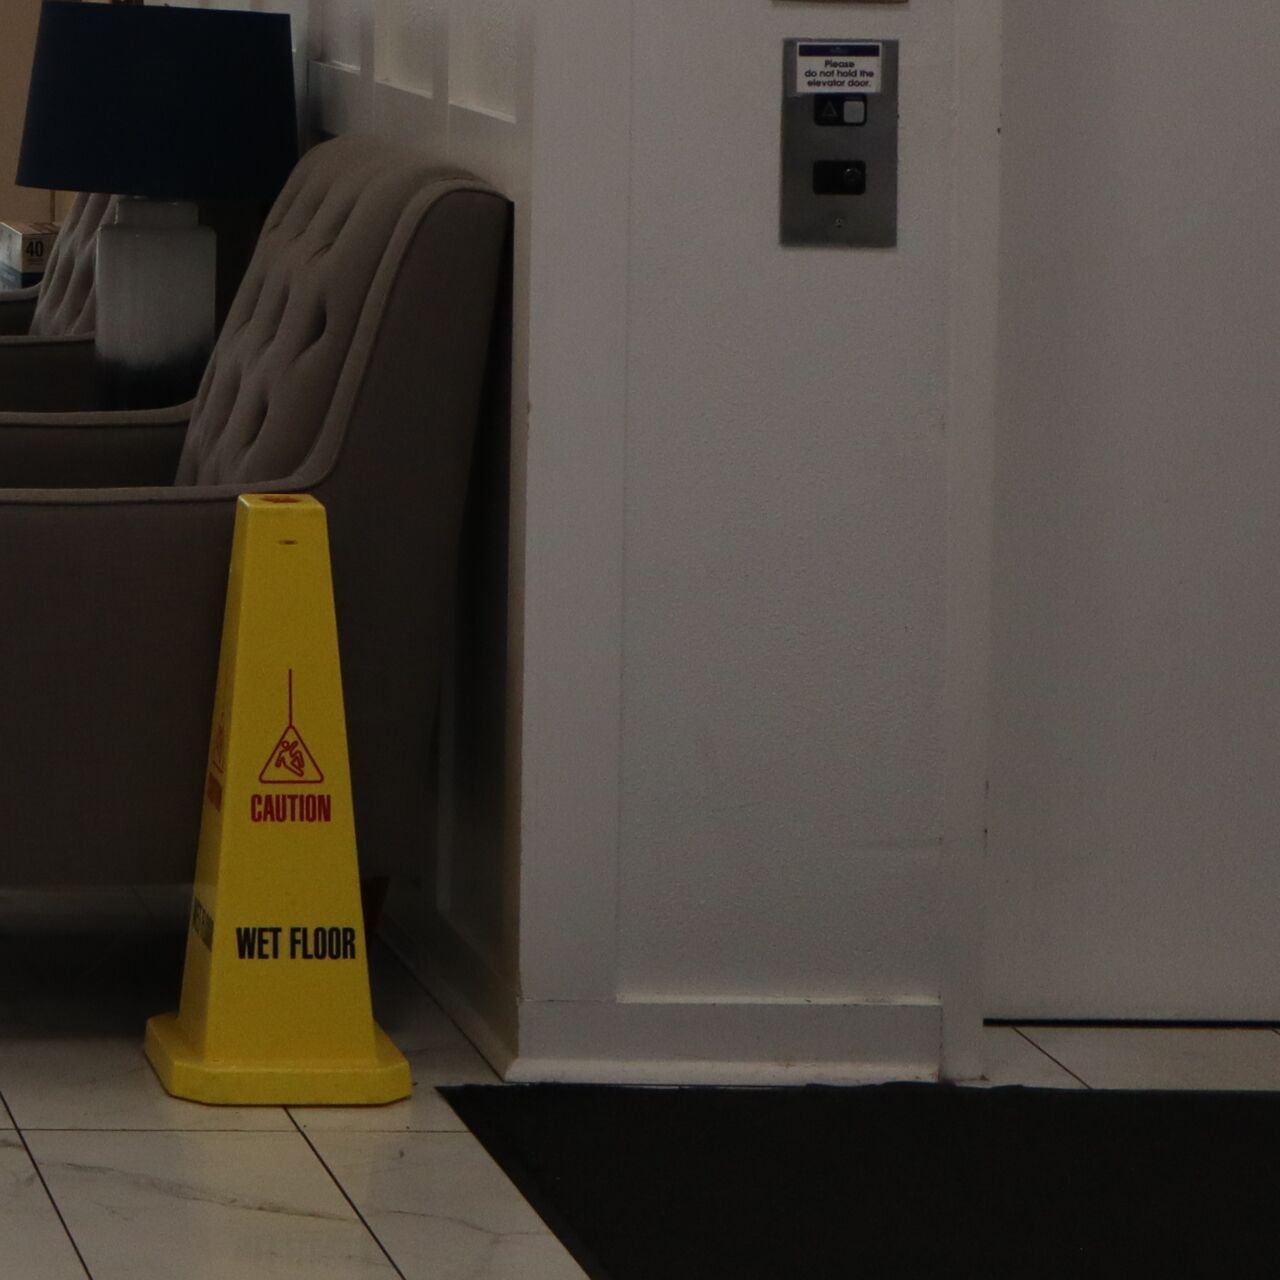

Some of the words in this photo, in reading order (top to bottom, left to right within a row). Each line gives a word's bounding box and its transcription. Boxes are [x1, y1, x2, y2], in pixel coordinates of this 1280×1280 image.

[824, 59, 855, 68] Please
[804, 69, 817, 77] do
[819, 69, 835, 77] not
[837, 69, 858, 77] hold
[859, 69, 874, 77] the
[807, 79, 845, 87] elevator
[26, 240, 44, 257] 40
[250, 794, 331, 823] CAUTION
[236, 927, 282, 959] WET
[290, 927, 356, 959] FLOOR
